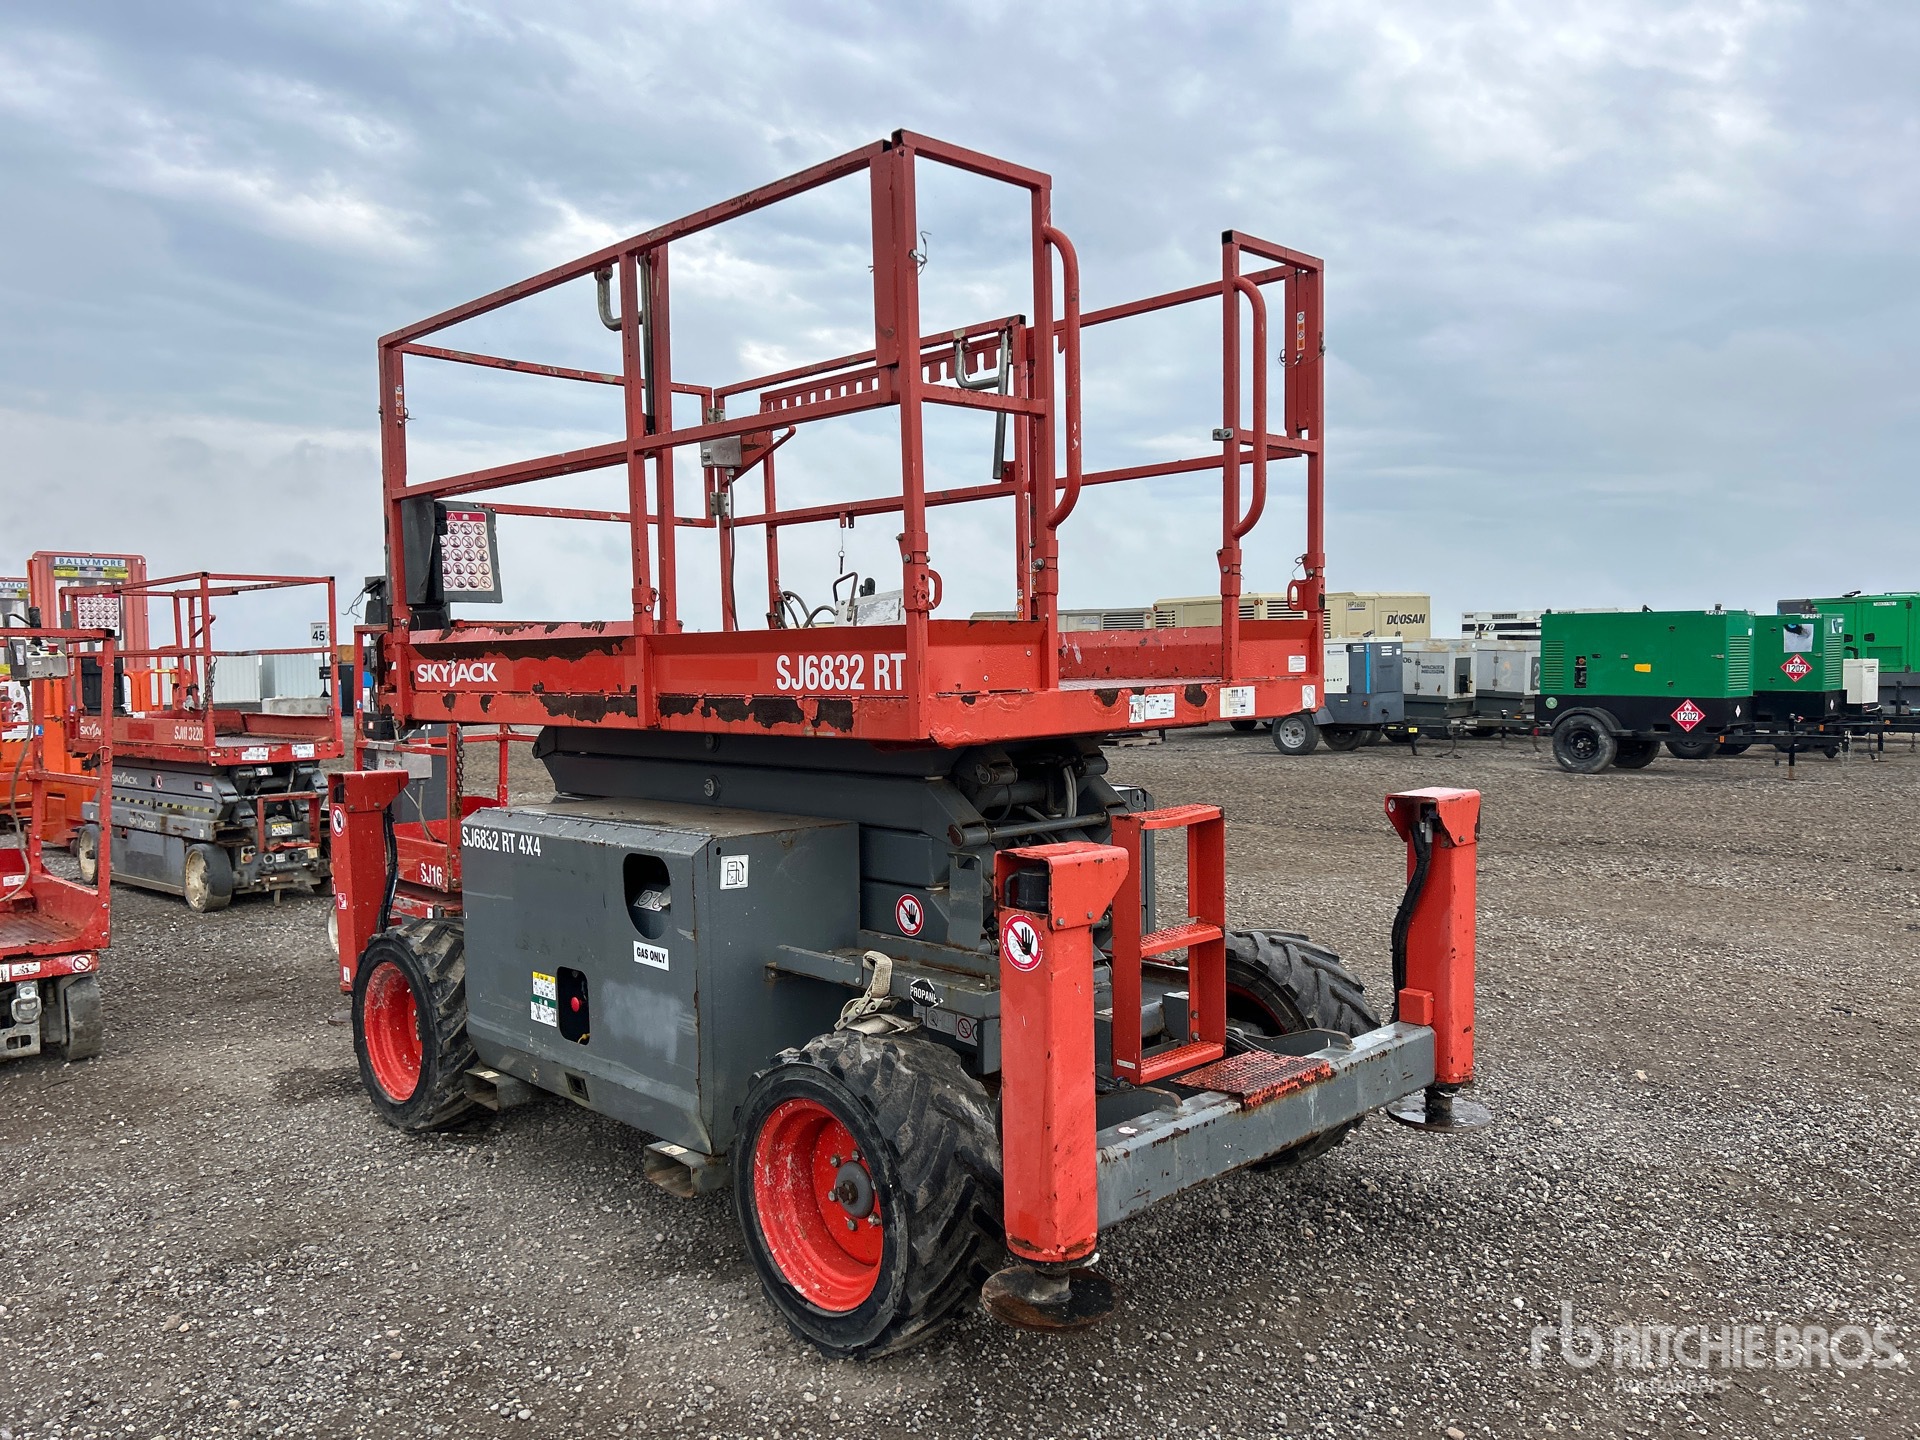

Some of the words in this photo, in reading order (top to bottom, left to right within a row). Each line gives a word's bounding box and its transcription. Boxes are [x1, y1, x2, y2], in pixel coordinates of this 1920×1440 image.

[58, 557, 123, 567] BALLYMORE
[1386, 613, 1426, 625] DOOSAN
[1483, 623, 1496, 631] 70
[312, 630, 326, 641] 45
[417, 660, 499, 688] SKYJACK
[776, 653, 865, 691] SJ6832
[873, 652, 907, 691] RT
[1788, 664, 1806, 673] 1202
[1678, 711, 1698, 721] 1202
[80, 723, 101, 738] SKYJA
[188, 726, 203, 741] 3220
[112, 772, 138, 785] SKYJACK
[461, 826, 500, 851] SJ6832
[501, 832, 516, 854] RT
[518, 834, 542, 857] 4X4
[420, 863, 443, 886] SJ16
[636, 946, 649, 960] GAS
[649, 950, 666, 965] ONLY
[909, 985, 938, 1004] PROPANE
